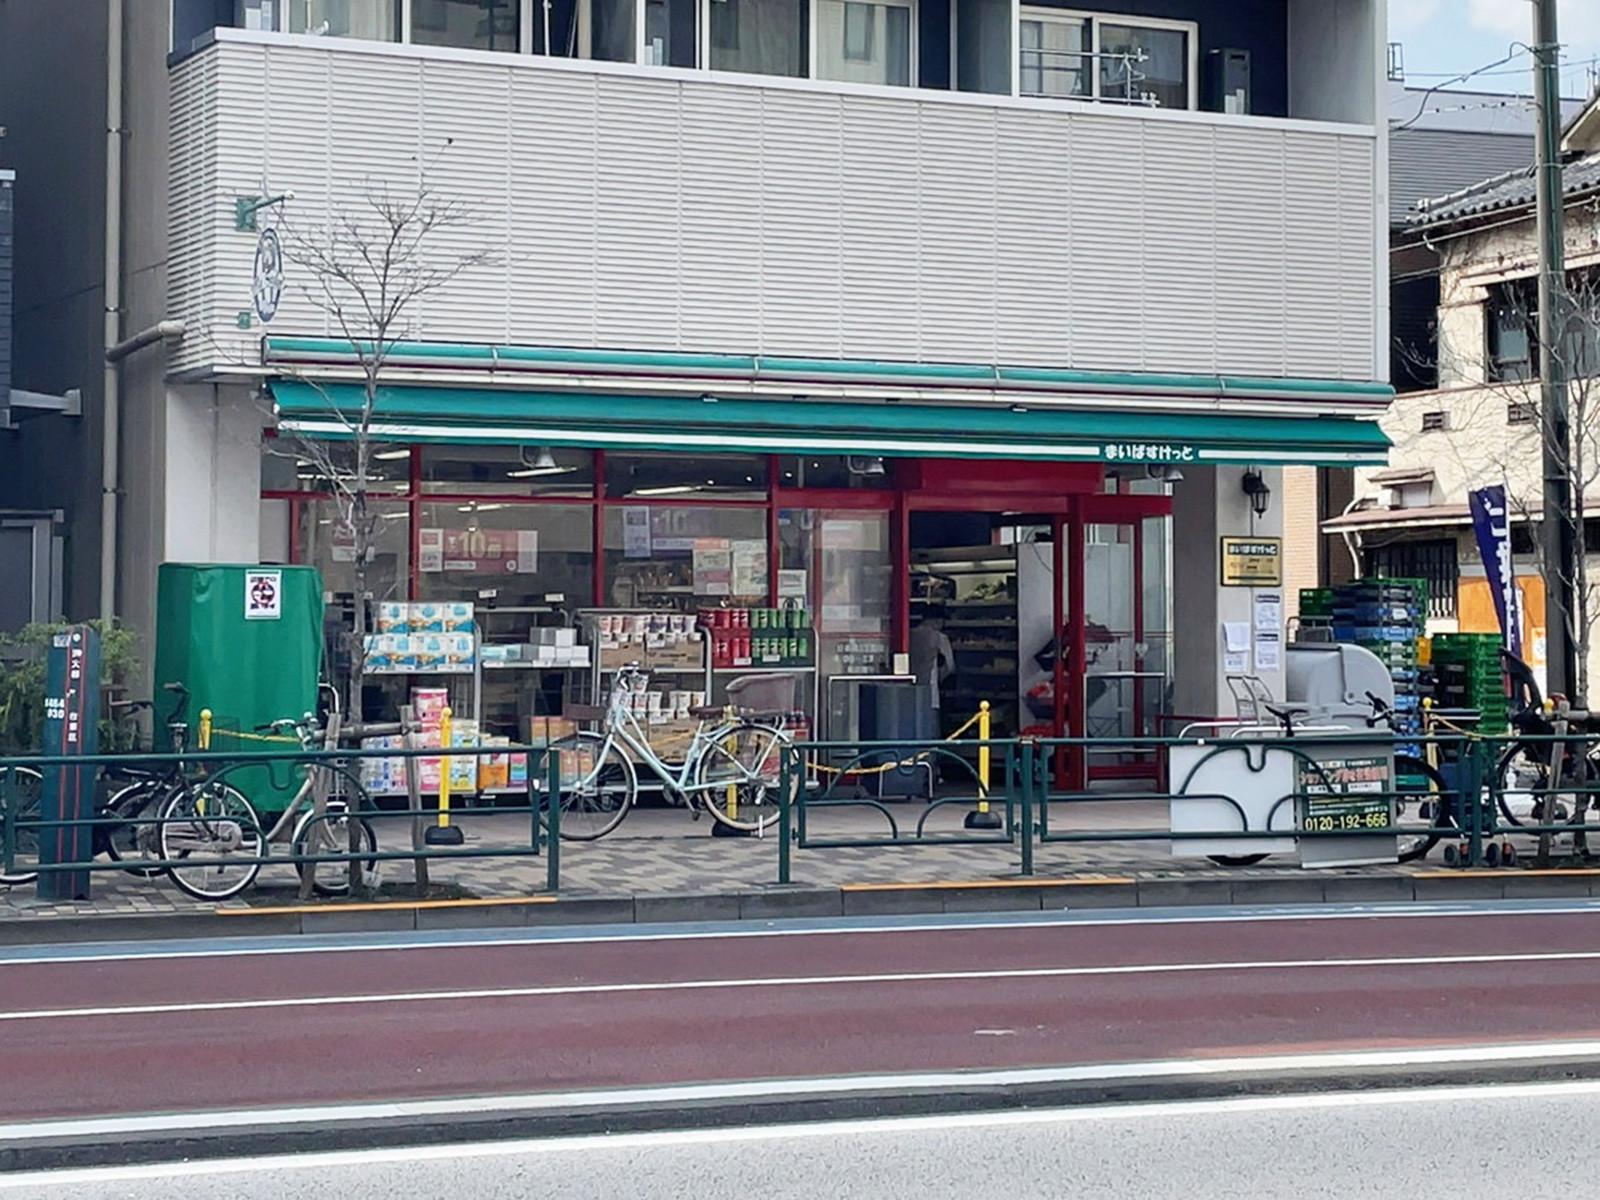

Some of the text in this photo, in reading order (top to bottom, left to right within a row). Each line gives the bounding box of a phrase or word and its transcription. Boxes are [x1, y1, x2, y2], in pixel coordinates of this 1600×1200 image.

[1105, 444, 1194, 461] まいばすけっと
[1304, 813, 1388, 831] 0120-192-666
